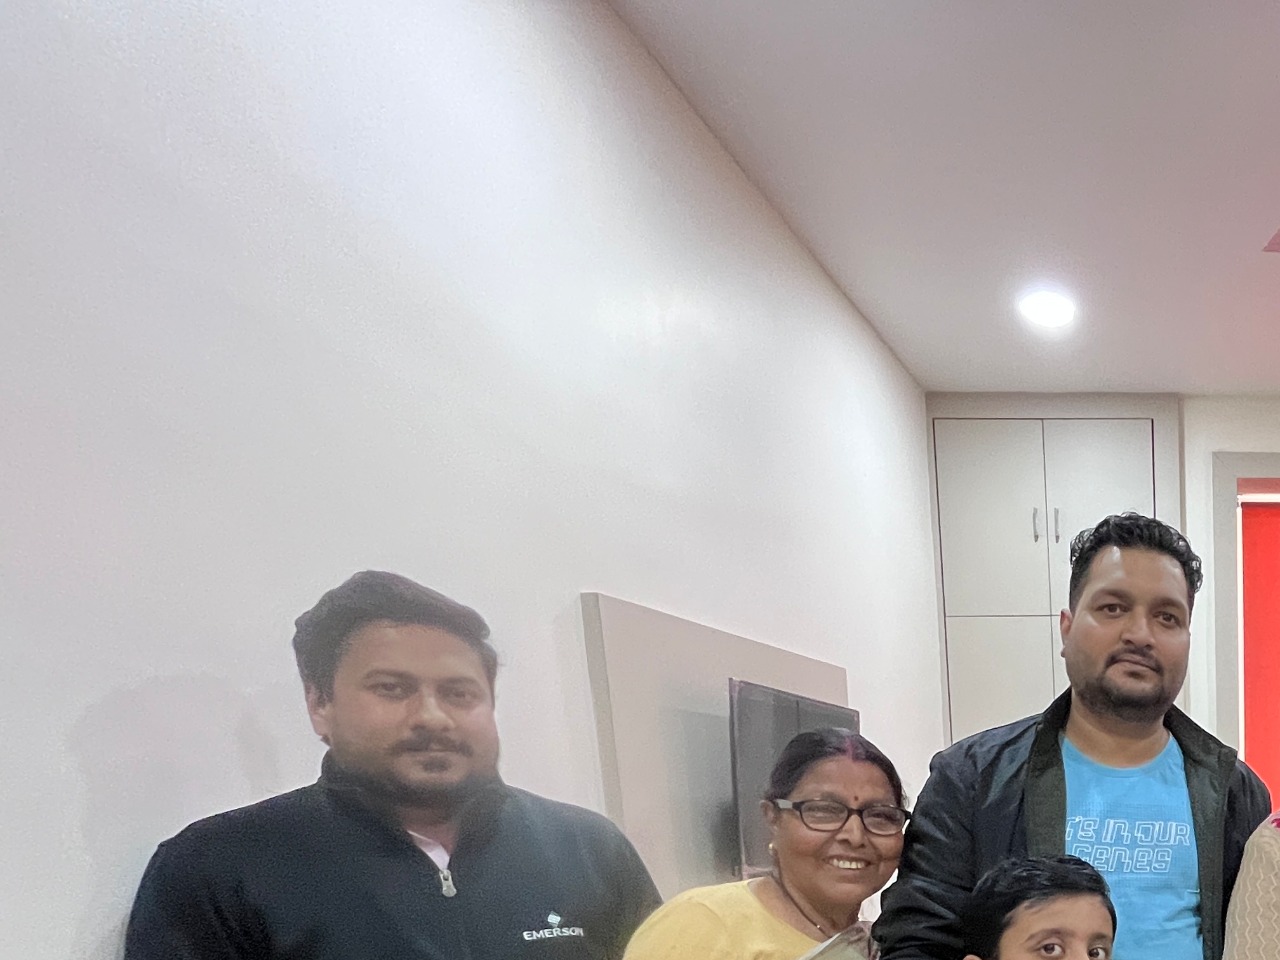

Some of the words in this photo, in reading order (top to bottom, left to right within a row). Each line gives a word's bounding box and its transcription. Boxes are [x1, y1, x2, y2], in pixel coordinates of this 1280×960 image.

[1066, 816, 1099, 842] T'S
[1101, 819, 1132, 845] IN
[1134, 821, 1190, 846] OUR
[522, 926, 584, 941] EMERSON
